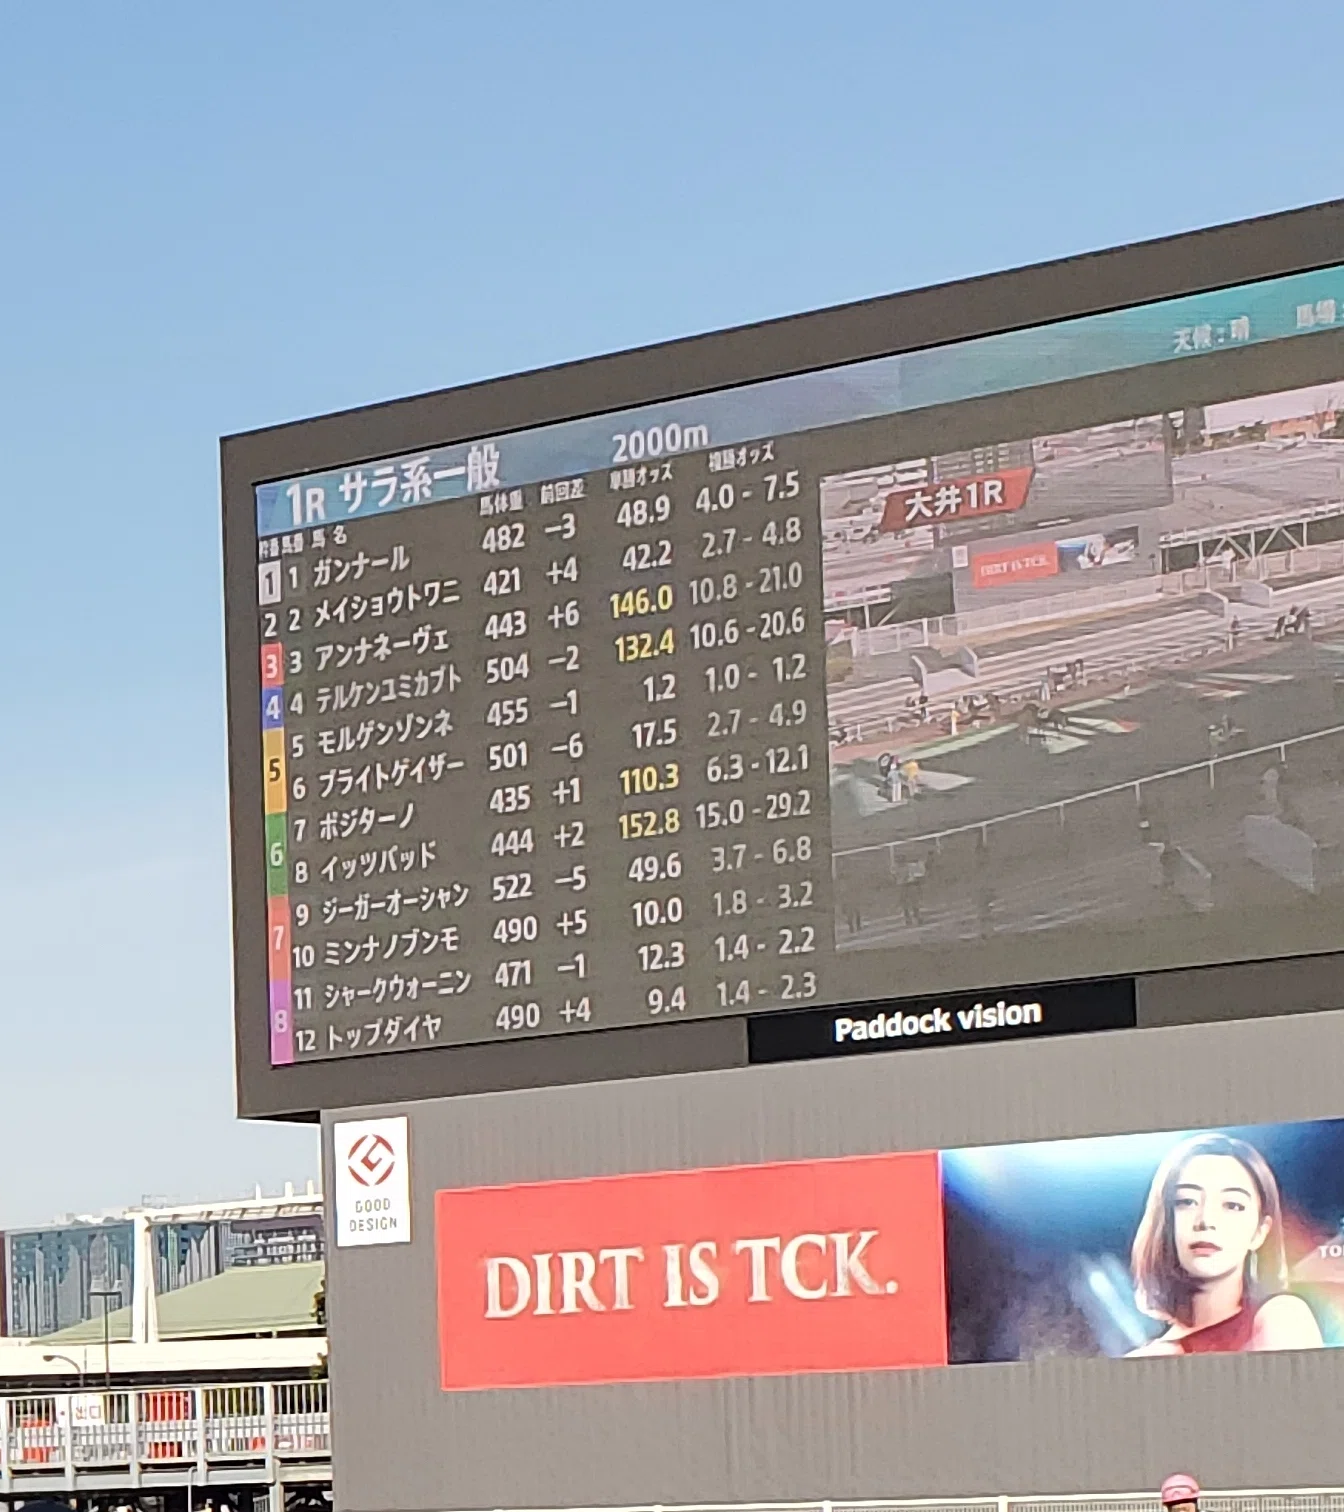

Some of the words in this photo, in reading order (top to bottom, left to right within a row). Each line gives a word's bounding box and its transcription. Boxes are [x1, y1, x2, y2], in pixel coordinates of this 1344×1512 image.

[286, 483, 325, 525] 1R
[339, 443, 500, 513] サラ系一般
[613, 423, 709, 463] 2000m
[905, 480, 1003, 521] 大井1R
[264, 613, 277, 637] 2
[289, 609, 301, 632] 2
[314, 580, 460, 628] メイショウトワニ
[483, 568, 520, 596] 421
[623, 540, 672, 571] 42.2
[702, 528, 736, 559] 2.7
[762, 517, 801, 546] 4.8
[265, 572, 275, 597] 1
[289, 567, 298, 589] 1
[314, 545, 410, 587] ガンナール
[482, 523, 525, 553] 482
[617, 496, 670, 528] 48.9
[696, 484, 734, 513] 4.0
[764, 470, 800, 502] 7.5
[265, 695, 281, 720] 4
[290, 692, 303, 715] 4
[486, 652, 529, 684] 504
[615, 627, 674, 662] 132.4
[690, 619, 739, 650] 10.6
[760, 607, 805, 639] 20.6
[266, 654, 278, 679] 3
[289, 651, 302, 674] 3
[315, 623, 449, 671] アンナネーヴェ
[485, 610, 527, 640] 443
[611, 585, 673, 620] 146.0
[689, 573, 738, 606] 10.8
[760, 562, 802, 593] 21.0
[292, 735, 304, 758] 5
[487, 698, 528, 727] 455
[643, 674, 676, 702] 1.2
[705, 663, 740, 693] 1.0
[772, 653, 806, 683] 1.2
[269, 758, 281, 782] 5
[293, 777, 306, 800] 6
[489, 741, 528, 771] 501
[632, 718, 677, 749] 17.5
[707, 709, 741, 737] 2.7
[769, 699, 807, 727] 4.9
[294, 819, 306, 842] 7
[490, 785, 531, 814] 435
[620, 763, 679, 795] 110.3
[707, 754, 743, 782] 6.3
[766, 744, 808, 774] 12.1
[270, 842, 283, 867] 6
[295, 861, 308, 884] 8
[491, 828, 533, 857] 444
[619, 808, 679, 839] 152.8
[696, 799, 744, 829] 15.0
[766, 789, 810, 820] 29.2
[293, 945, 314, 968] 10
[324, 927, 459, 966] ミンナノブンモ
[493, 916, 537, 943] 490
[632, 897, 683, 927] 10.0
[714, 890, 747, 916] 1.8
[778, 881, 813, 909] 3.2
[295, 904, 308, 926] 9
[323, 883, 469, 924] ジーガーオーシャン
[493, 873, 532, 901] 522
[629, 852, 682, 882] 49.6
[712, 844, 746, 872] 3.7
[773, 836, 811, 864] 6.8
[272, 925, 284, 950] 7
[294, 987, 312, 1010] 11
[325, 970, 471, 1008] シャークウォーニン
[495, 960, 531, 988] 471
[638, 942, 685, 971] 12.3
[715, 934, 749, 962] 1.4
[778, 926, 815, 955] 2.2
[274, 1009, 288, 1033] 8
[296, 1030, 316, 1052] 12
[329, 1014, 442, 1051] トップダイヤ
[496, 1002, 540, 1031] 490
[648, 986, 686, 1014] 9.4
[717, 980, 750, 1007] 1.4
[781, 971, 816, 1000] 2.3
[833, 1007, 952, 1042] Paddock
[956, 1001, 1042, 1030] vision
[350, 1217, 398, 1232] DESIGN
[355, 1198, 391, 1213] GOOD
[485, 1245, 644, 1319] DIRT
[662, 1241, 720, 1308] IS
[732, 1229, 900, 1303] TCK.
[1318, 1244, 1344, 1259] TO
